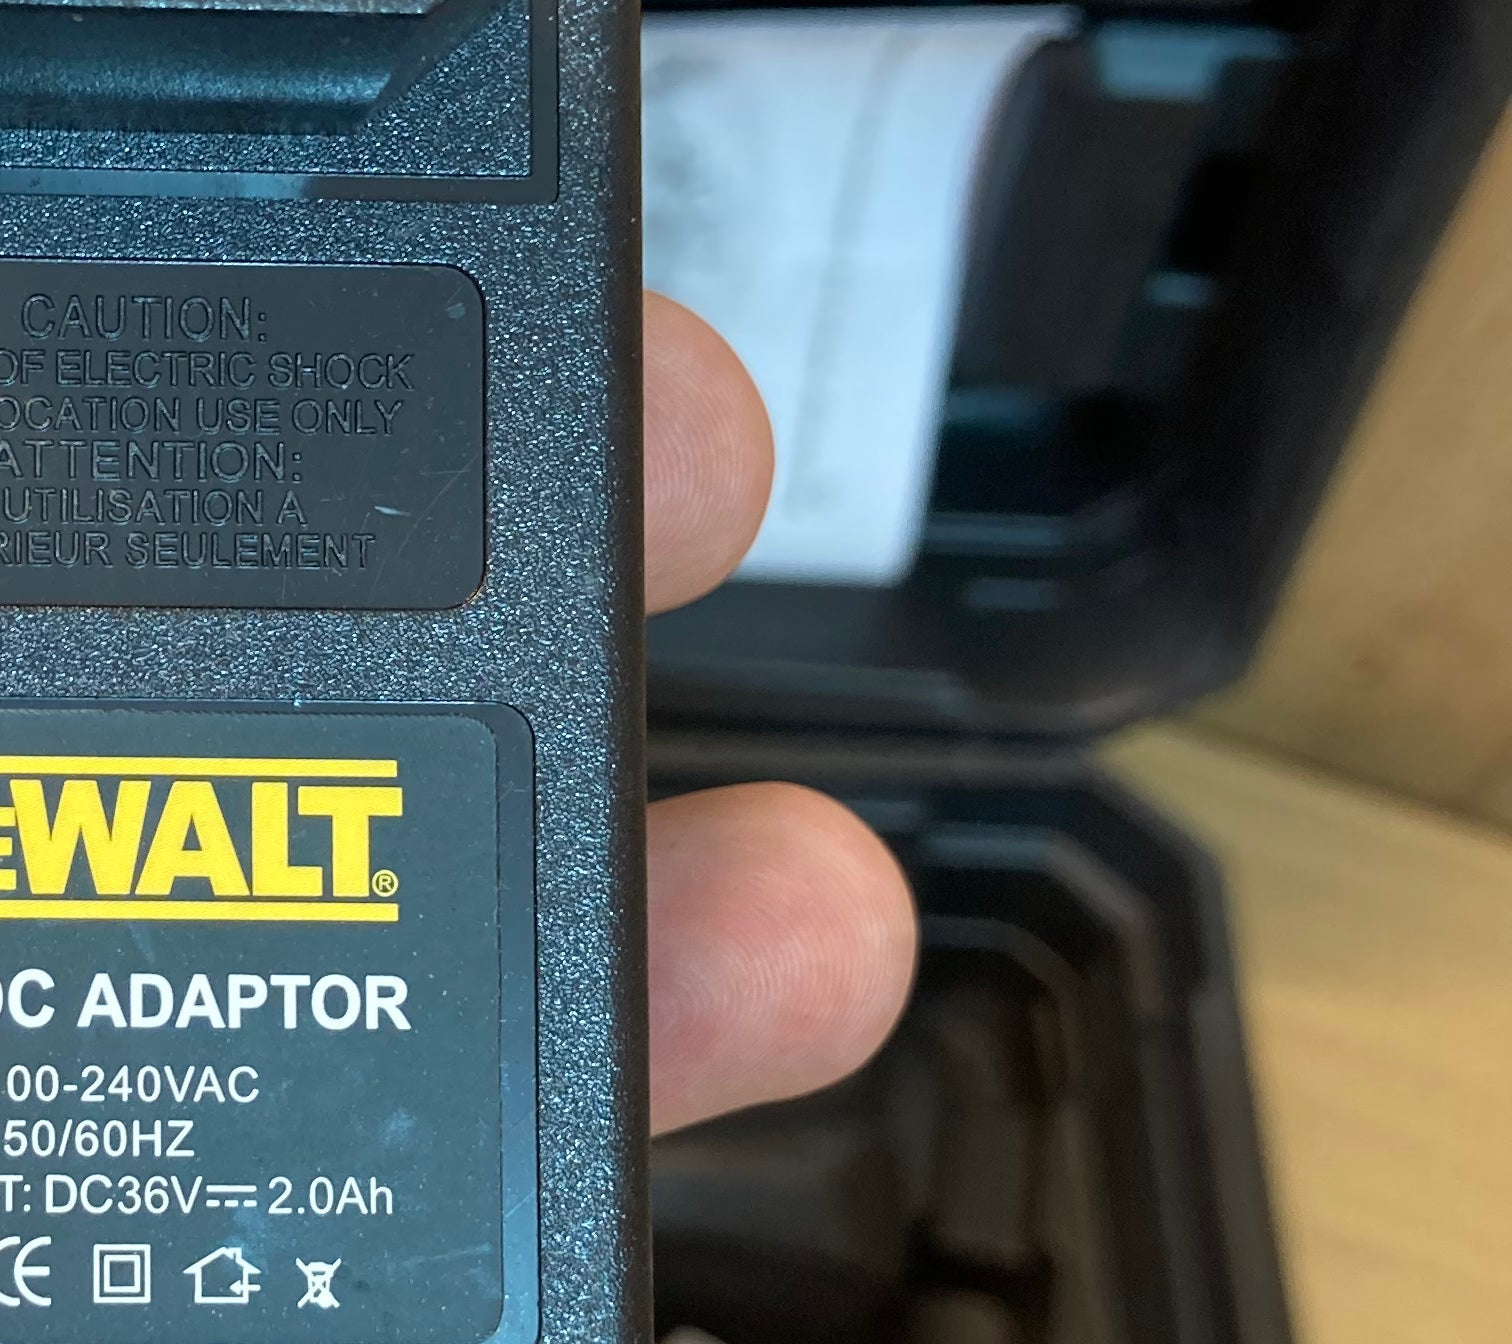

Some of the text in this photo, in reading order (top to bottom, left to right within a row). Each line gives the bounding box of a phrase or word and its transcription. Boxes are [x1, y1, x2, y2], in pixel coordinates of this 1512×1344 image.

[21, 293, 269, 344] CAUTION:
[55, 349, 257, 392] ELECTRIC
[266, 351, 415, 394] SHOCK
[194, 398, 281, 436] USE
[290, 398, 405, 437] ONLY
[2, 486, 264, 527] UTILISATION
[276, 489, 309, 529] A
[125, 532, 376, 570] SEULEMENT
[77, 973, 411, 1031] ADAPTOR
[2, 1118, 195, 1159] 50/60HZ
[267, 1177, 394, 1216] 2.0Ah
